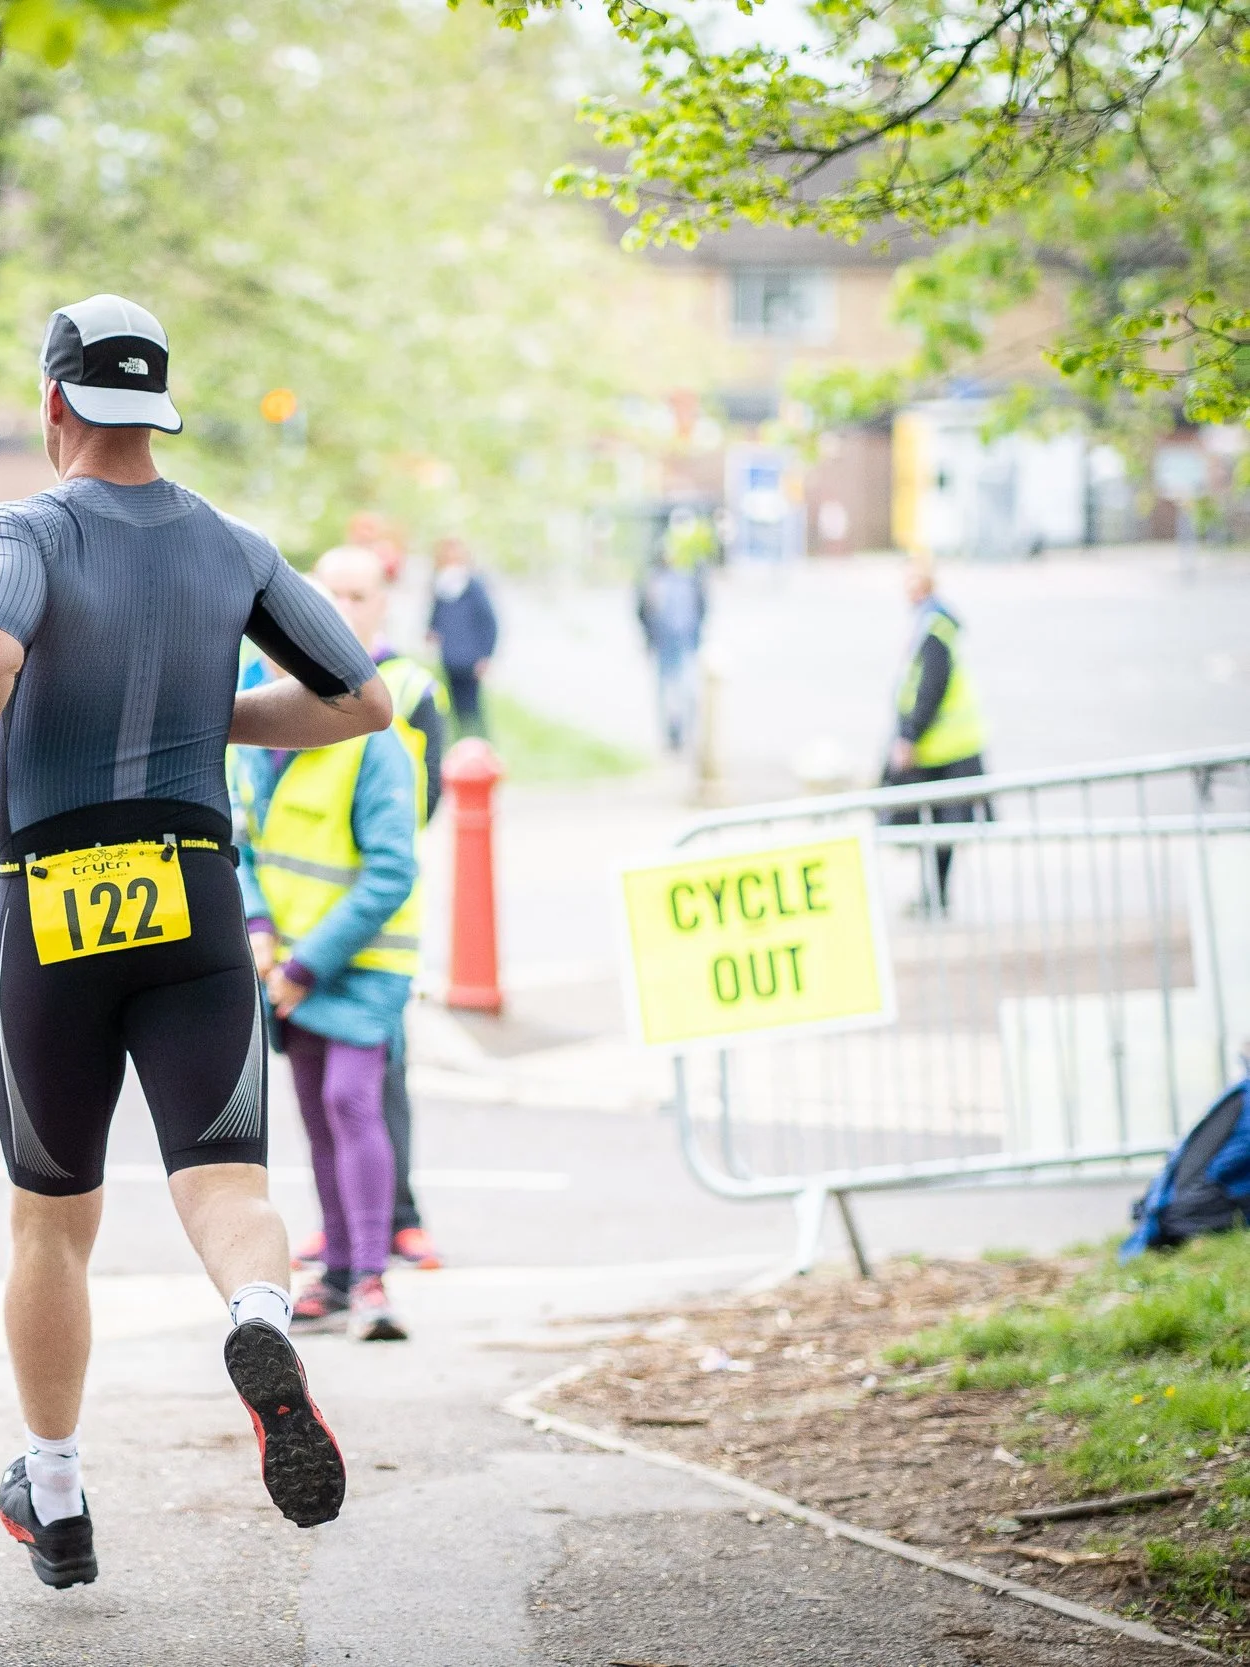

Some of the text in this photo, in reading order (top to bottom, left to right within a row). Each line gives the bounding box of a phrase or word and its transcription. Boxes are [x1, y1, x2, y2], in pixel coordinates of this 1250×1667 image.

[63, 877, 163, 951] 122
[669, 862, 828, 931] CYCLE
[713, 945, 802, 1003] OUT
